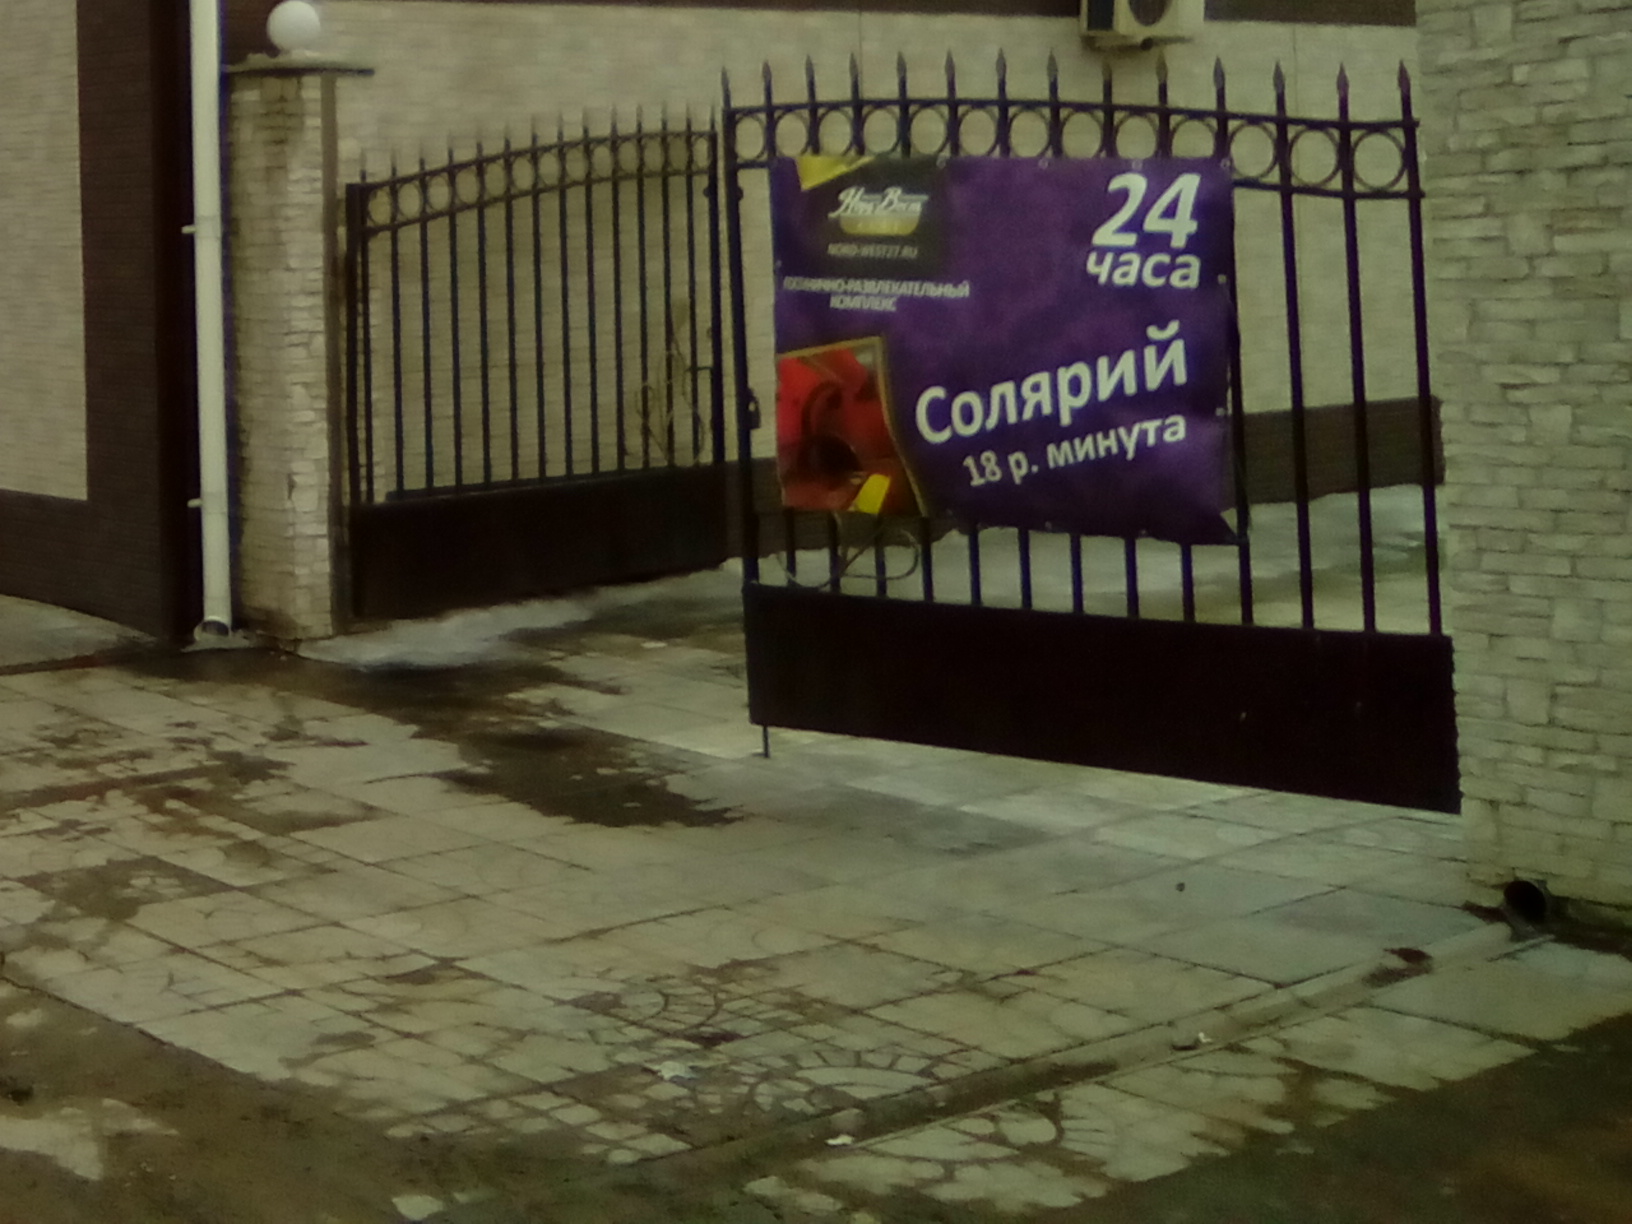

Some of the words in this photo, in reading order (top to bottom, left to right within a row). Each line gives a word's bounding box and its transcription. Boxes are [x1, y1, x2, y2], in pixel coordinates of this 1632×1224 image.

[1091, 172, 1202, 249] 24
[829, 294, 898, 312] КОМПЛЕКС
[1085, 248, 1202, 290] часа
[915, 319, 1189, 445] Солярий
[961, 449, 1003, 487] 18
[1007, 451, 1039, 485] р.
[1045, 414, 1187, 470] минута
